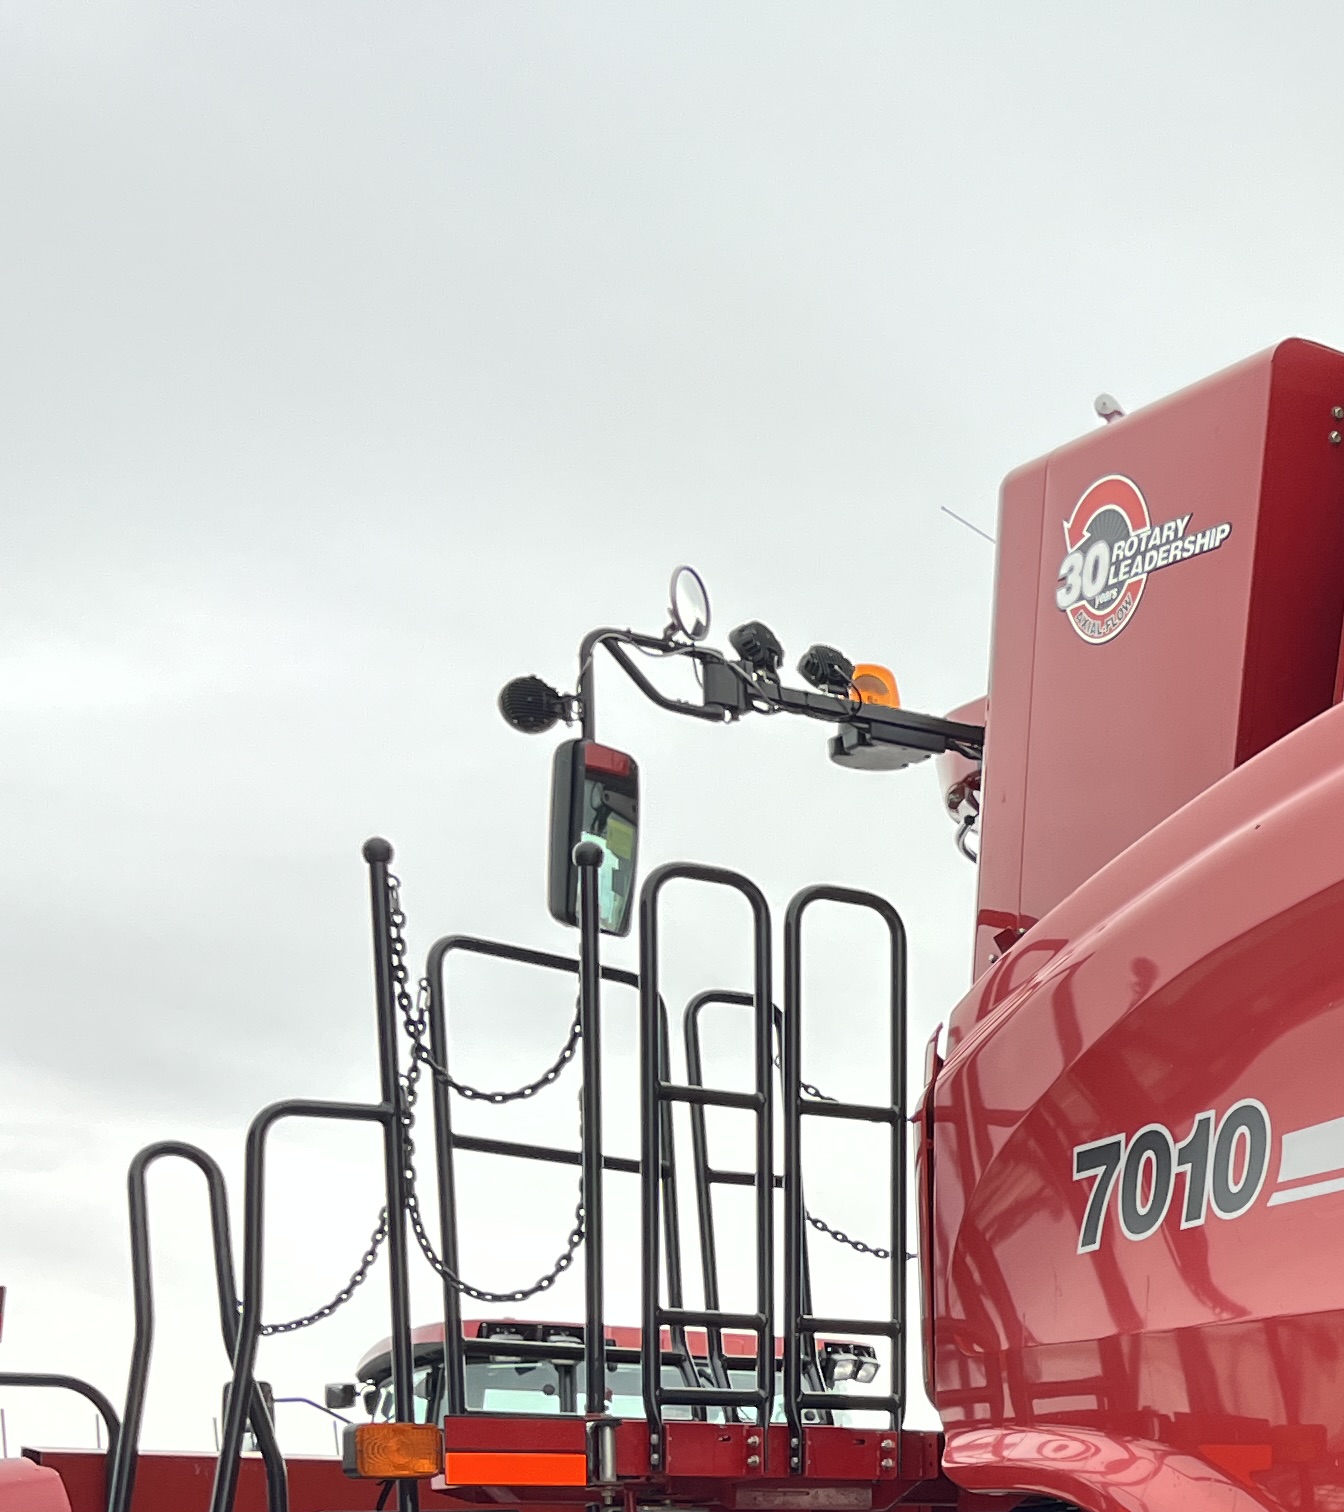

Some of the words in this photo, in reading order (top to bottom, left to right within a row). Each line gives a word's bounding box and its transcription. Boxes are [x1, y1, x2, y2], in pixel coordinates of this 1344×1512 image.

[1111, 512, 1193, 563] ROTARY
[1056, 540, 1111, 611] 30
[1107, 522, 1231, 586] LEADERSHIP
[1074, 591, 1134, 637] AXIAL-FLOW
[1095, 587, 1118, 609] years
[1073, 1098, 1271, 1255] 7010
